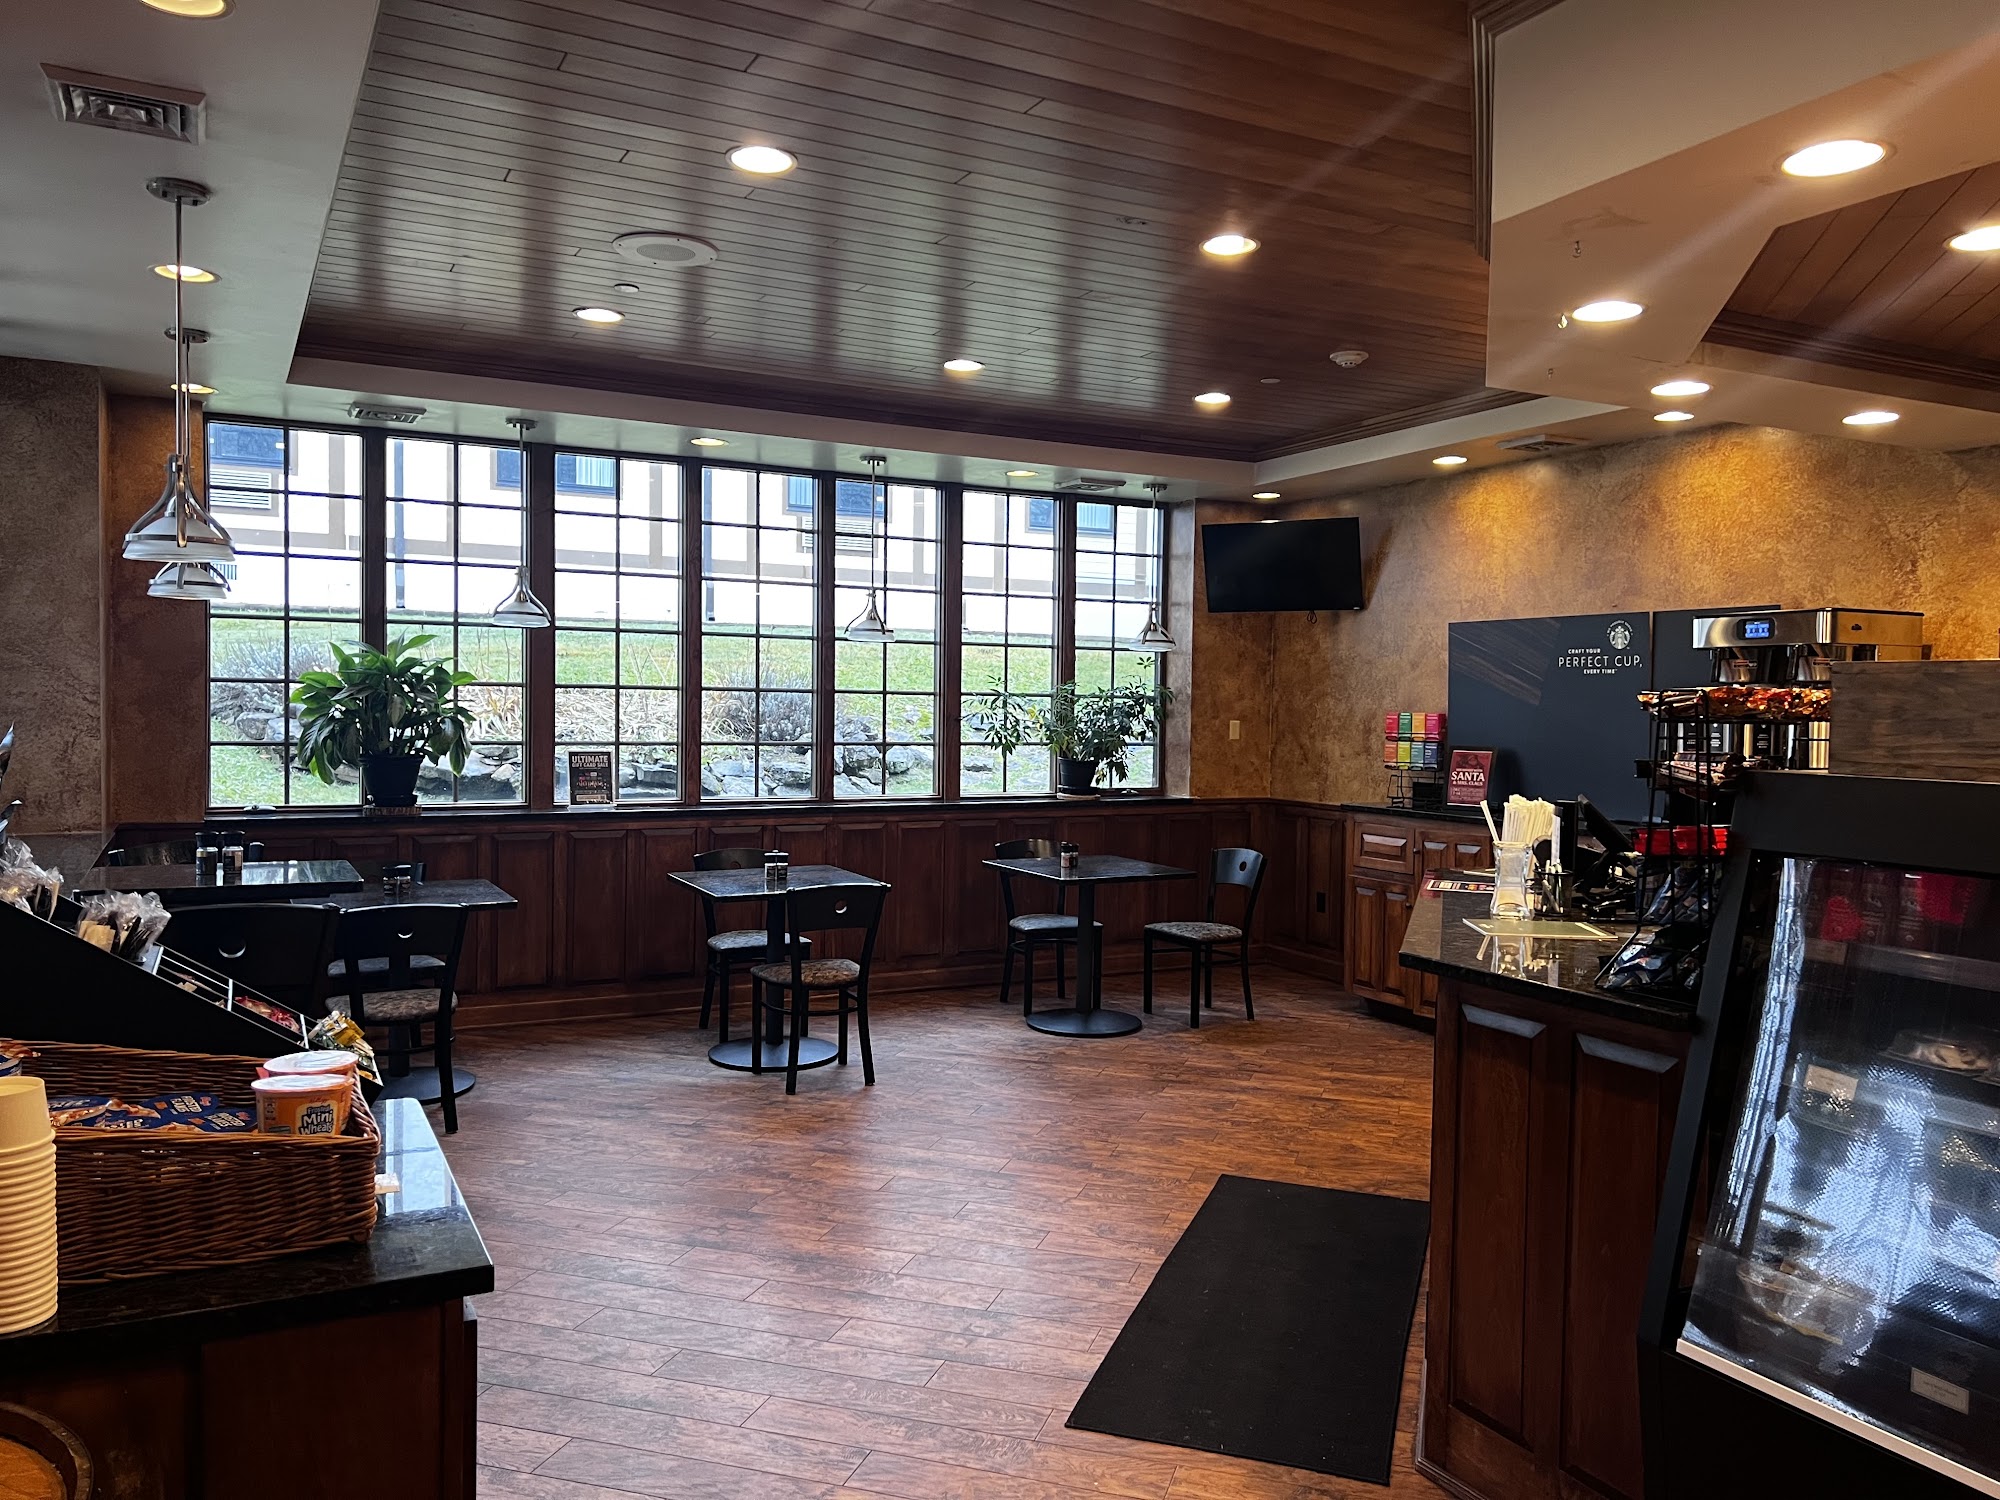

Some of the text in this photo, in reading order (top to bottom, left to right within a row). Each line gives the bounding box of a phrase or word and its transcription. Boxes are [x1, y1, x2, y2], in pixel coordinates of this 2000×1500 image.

[1558, 655, 1643, 668] PERFECT CUP,
[571, 755, 609, 763] ULTIMATE
[1451, 771, 1485, 782] SANTA
[302, 1110, 333, 1127] Mini
[300, 1121, 333, 1135] Wheats
